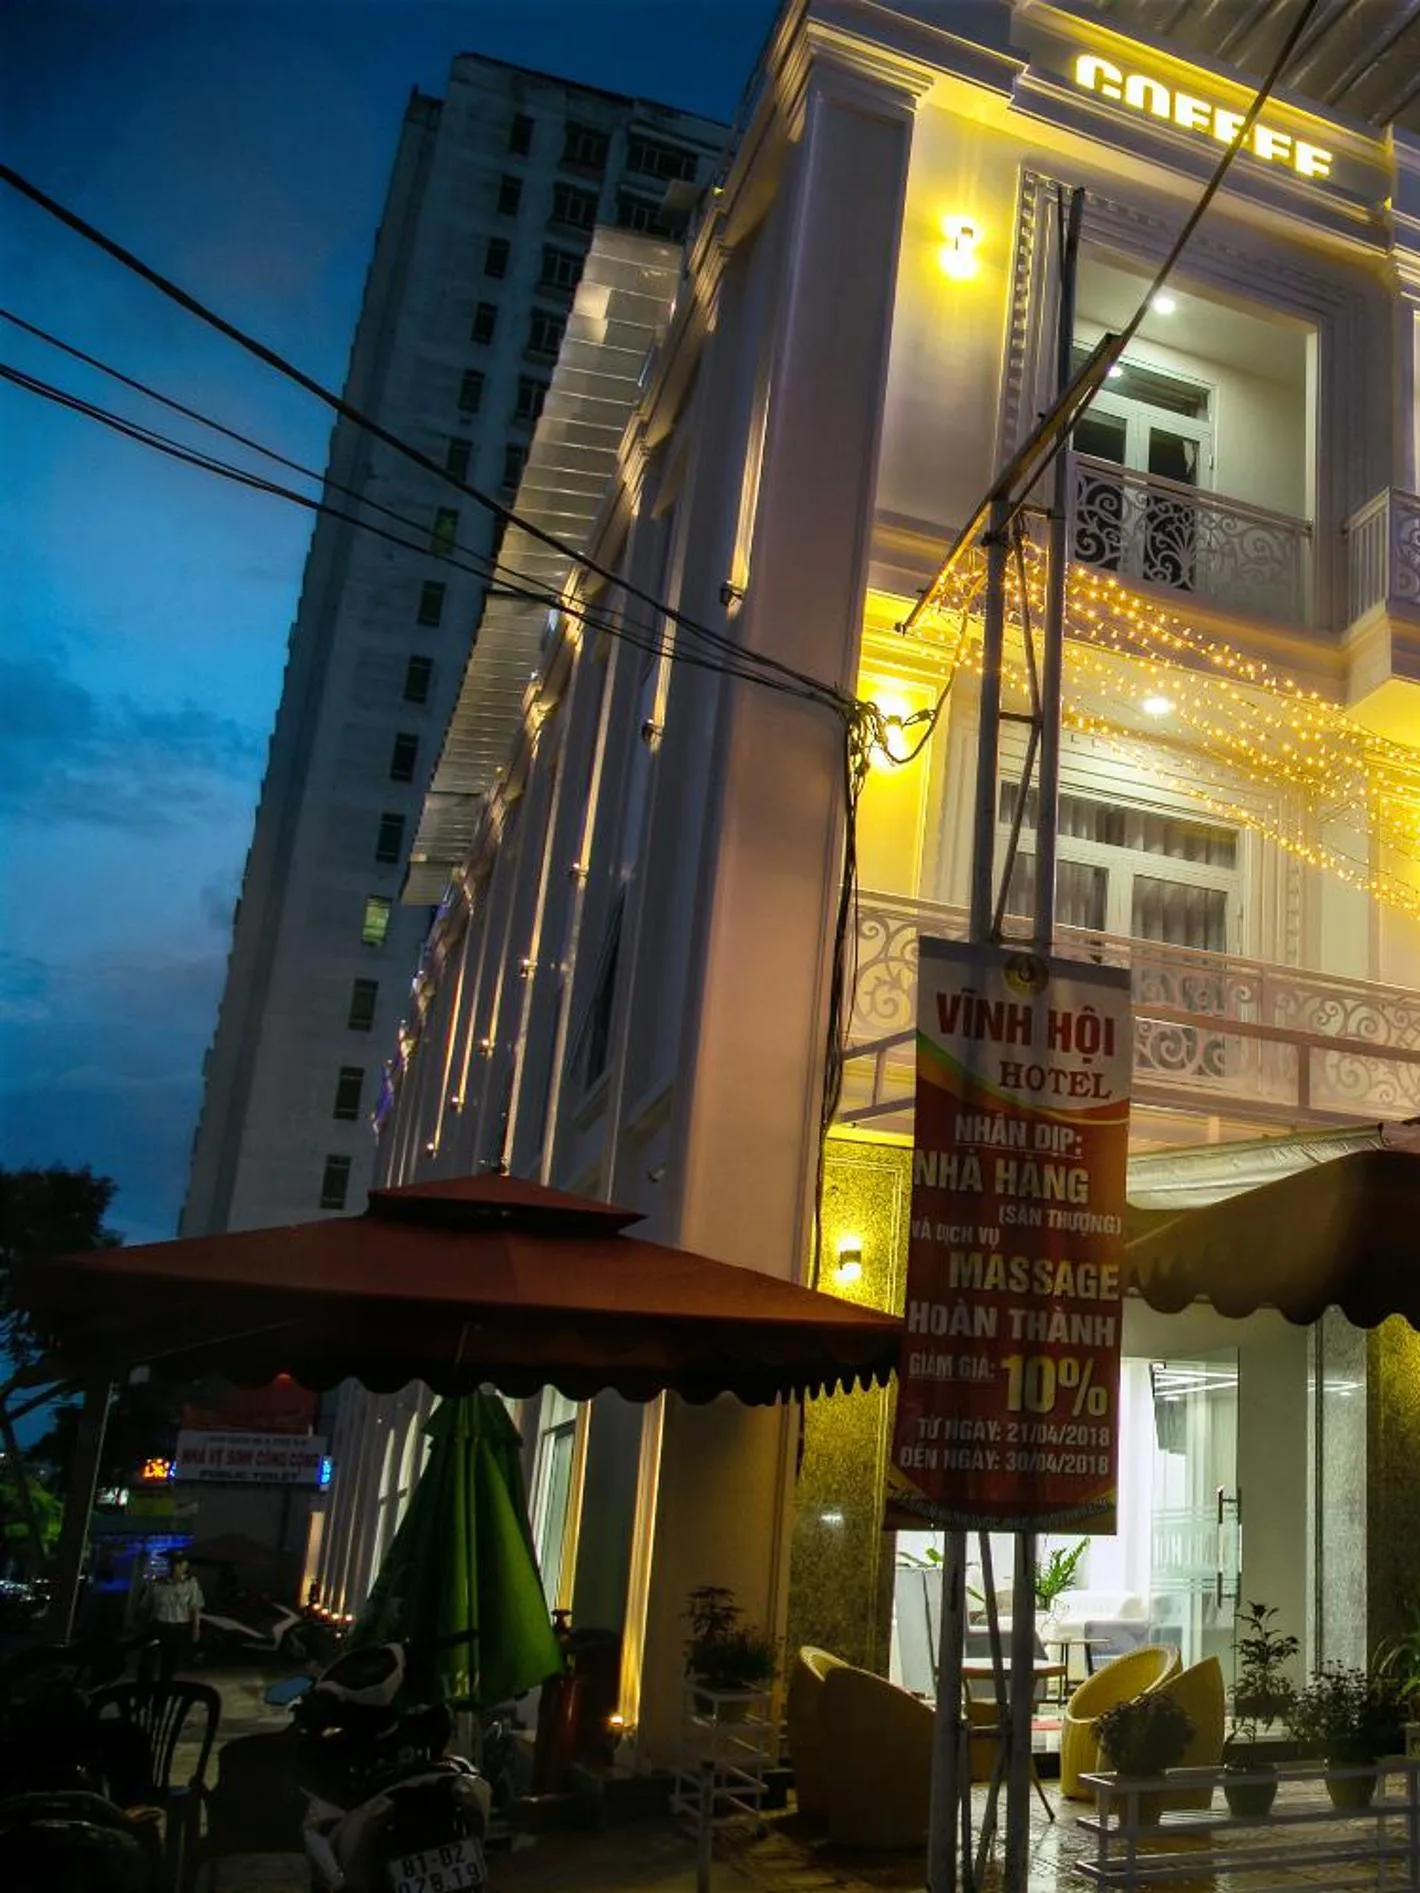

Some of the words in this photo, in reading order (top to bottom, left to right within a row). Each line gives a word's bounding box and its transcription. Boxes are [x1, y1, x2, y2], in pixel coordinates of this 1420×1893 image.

[936, 987, 1033, 1047] VĨNH
[1047, 1004, 1116, 1065] HỘI
[998, 1058, 1112, 1101] HOTEL
[915, 1147, 983, 1193] NHÀ
[995, 1153, 1090, 1205] HÀNG
[912, 1217, 932, 1241] VÀ
[978, 1226, 1001, 1250] VỤ
[948, 1250, 1120, 1301] MASSAGE
[907, 1299, 999, 1339] HOÀN
[1009, 1305, 1117, 1348] THÀNH
[1001, 1354, 1108, 1418] 10%
[945, 1417, 1001, 1442] NGÀY:
[1006, 1422, 1110, 1447] 21/04/2018
[942, 1447, 1000, 1472] NGÀY:
[1005, 1451, 1109, 1476] 30/04/2018
